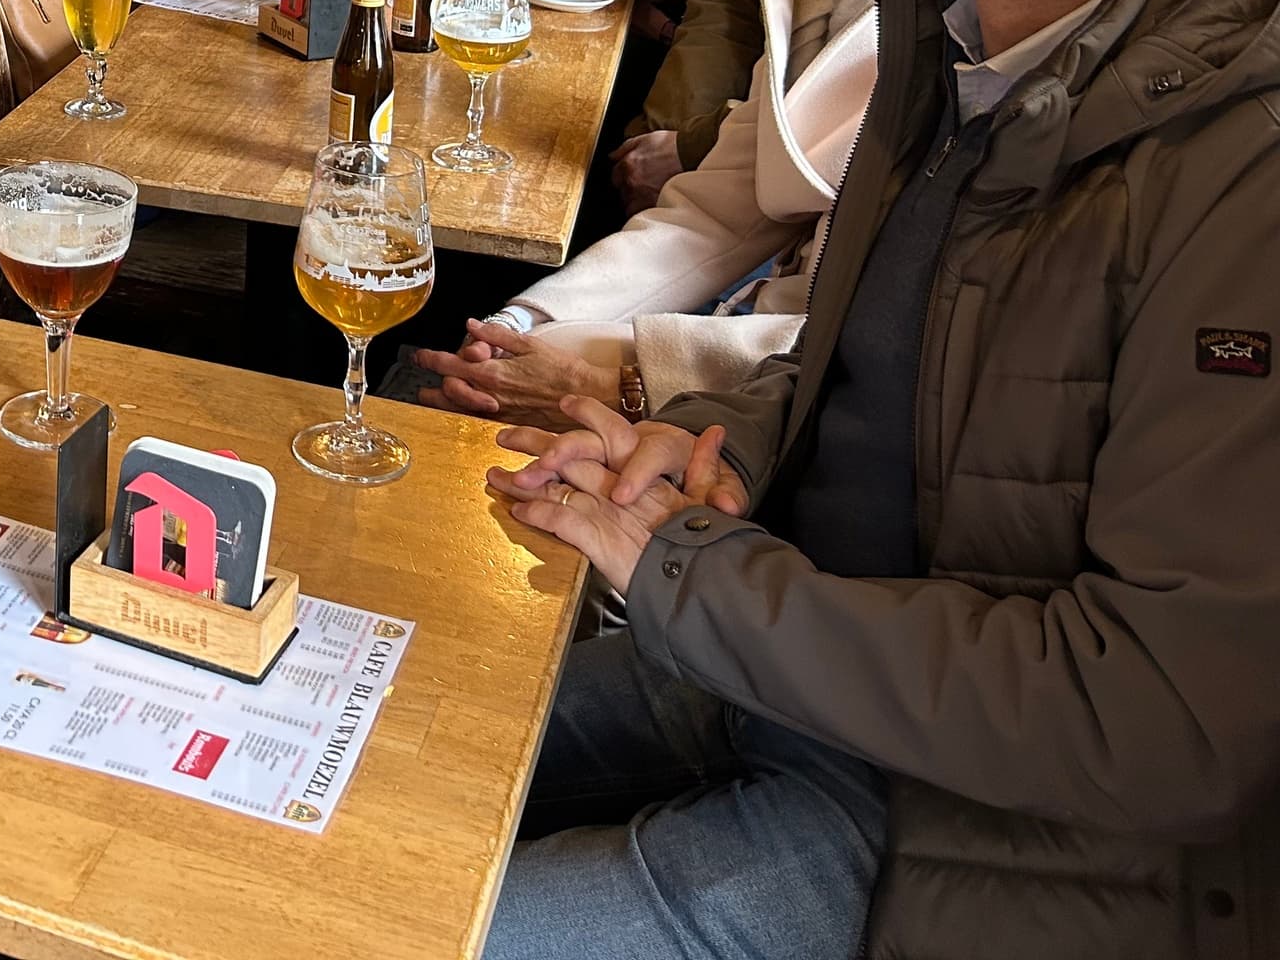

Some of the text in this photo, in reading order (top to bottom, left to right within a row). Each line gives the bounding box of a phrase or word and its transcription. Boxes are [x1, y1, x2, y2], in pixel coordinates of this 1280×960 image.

[271, 16, 295, 42] Duvel
[120, 591, 208, 649] Duvel
[361, 640, 393, 678] CAFE
[19, 697, 41, 719] CAVA
[303, 681, 373, 800] BLAUWMOEZEL
